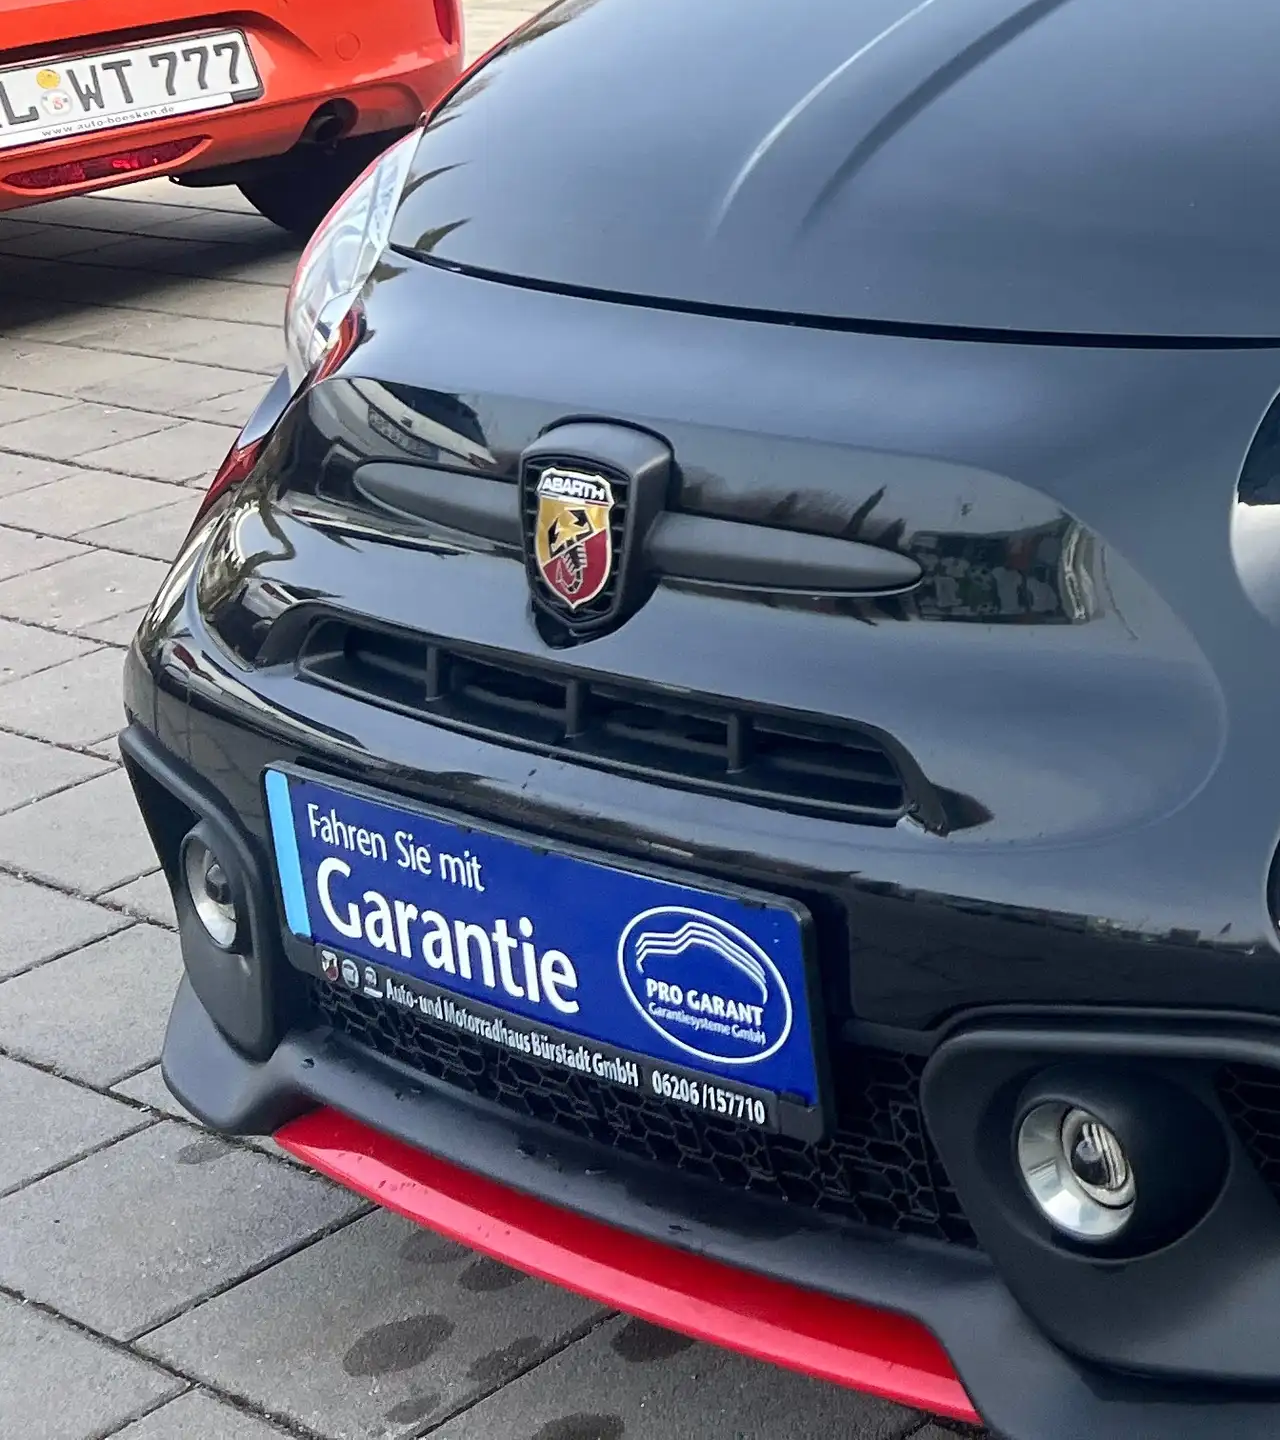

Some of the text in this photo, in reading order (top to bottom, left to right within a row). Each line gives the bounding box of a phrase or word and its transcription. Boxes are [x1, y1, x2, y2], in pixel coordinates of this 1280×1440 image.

[0, 40, 240, 127] L WT 777
[542, 477, 605, 500] ABARTH
[307, 803, 485, 892] Fahren Sie mit
[316, 857, 580, 1014] Garantie
[443, 998, 531, 1054] Motorradhaus
[531, 1031, 592, 1074] Bürstadt
[592, 1053, 639, 1088] GmbH
[646, 977, 764, 1027] PRO GARANT
[648, 1001, 767, 1047] Garantiesysteme GmbH
